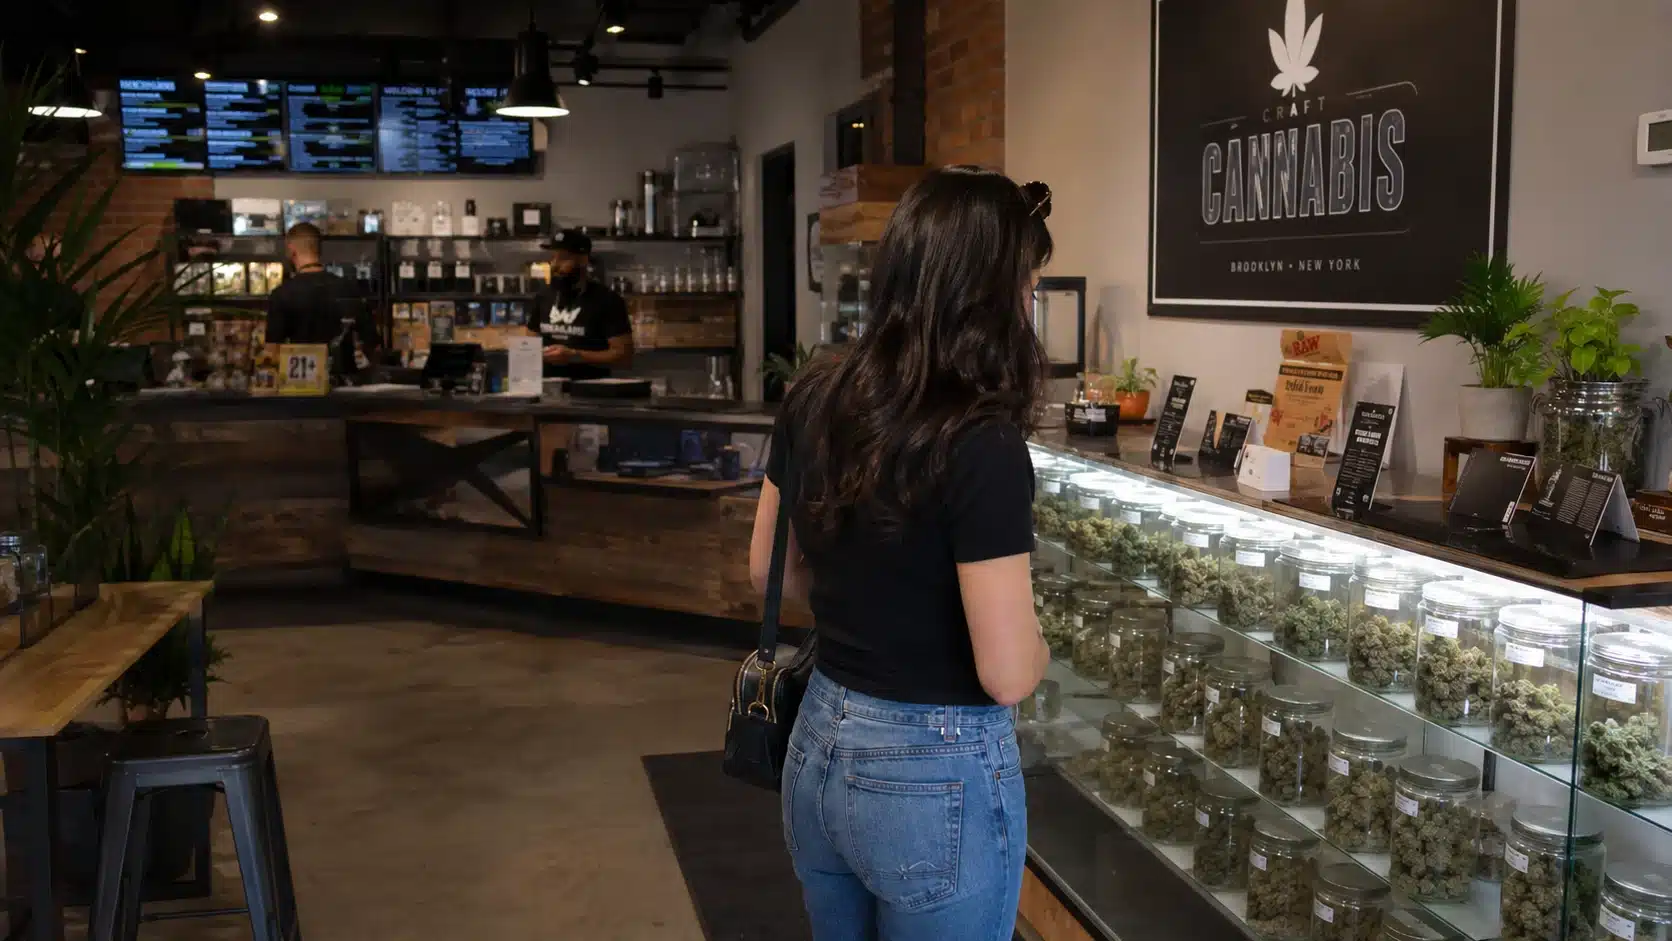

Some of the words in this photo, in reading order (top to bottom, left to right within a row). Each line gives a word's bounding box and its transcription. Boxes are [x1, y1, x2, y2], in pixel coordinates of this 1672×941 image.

[1262, 97, 1325, 122] CRAFT
[1202, 109, 1405, 225] CANNABIS
[1230, 259, 1284, 273] BROOKLYN
[1298, 259, 1323, 271] NEW
[1328, 258, 1361, 271] YORK
[1291, 335, 1321, 356] RAW
[289, 356, 316, 379] 21+
